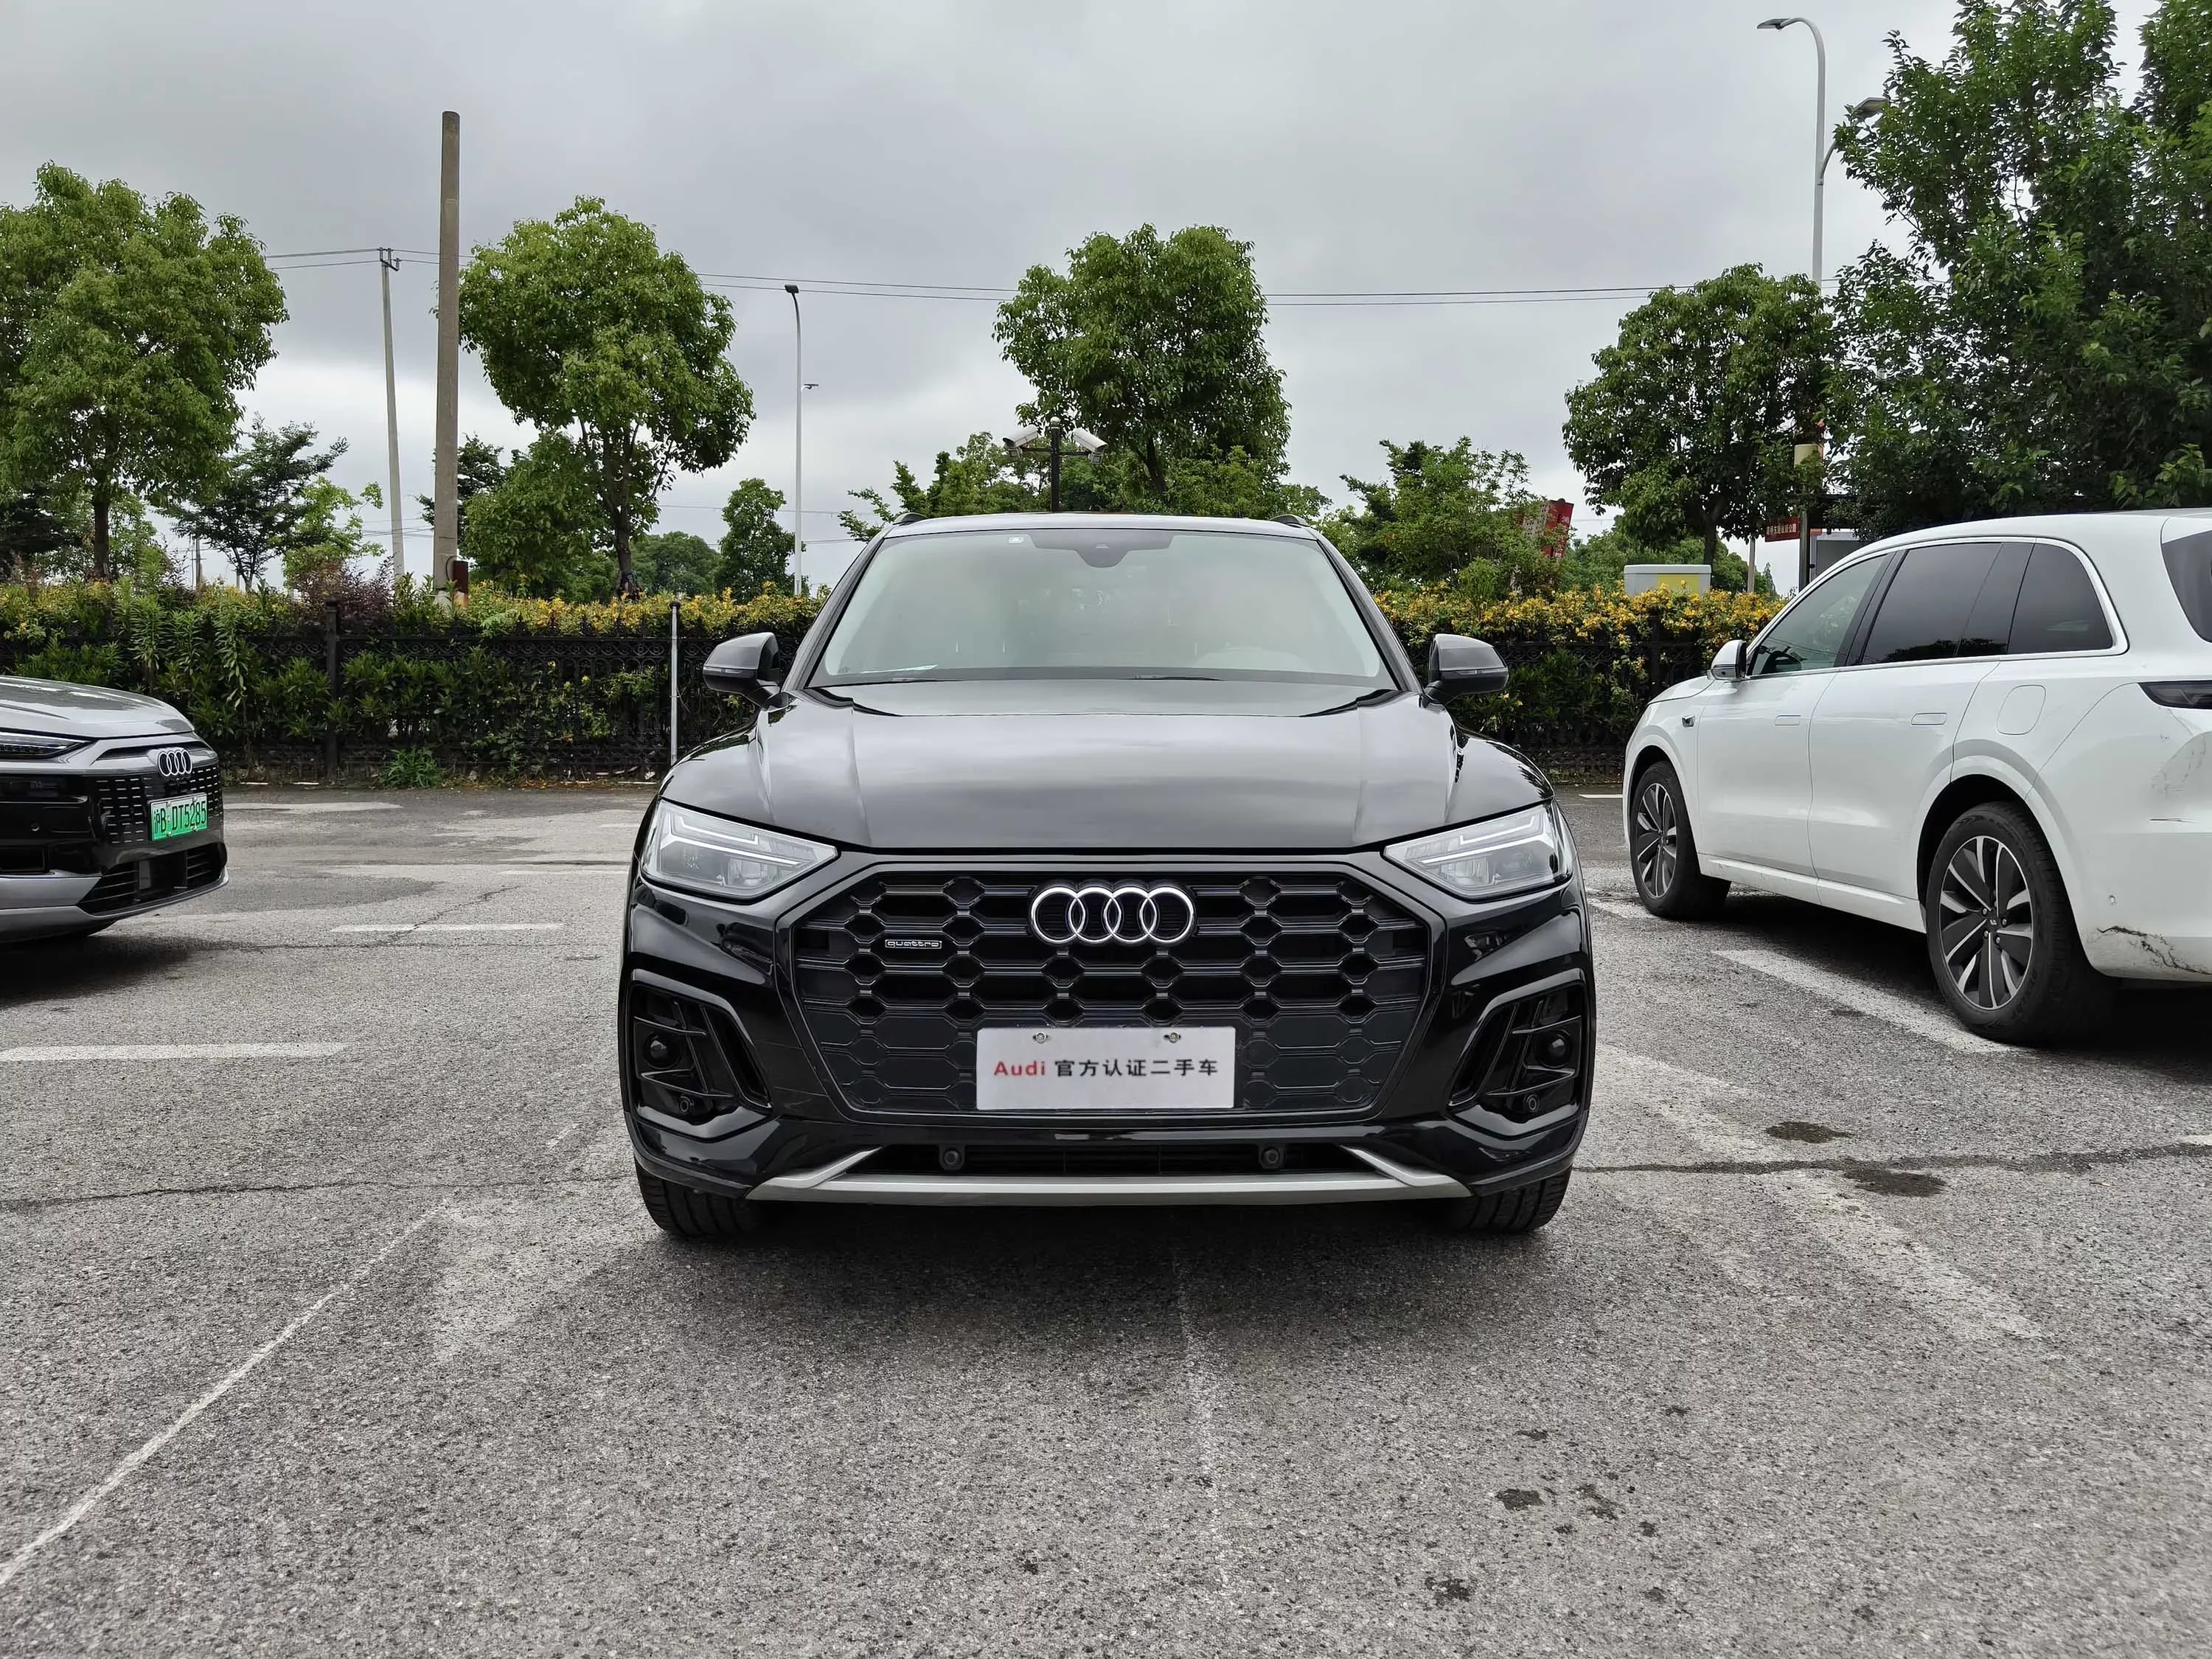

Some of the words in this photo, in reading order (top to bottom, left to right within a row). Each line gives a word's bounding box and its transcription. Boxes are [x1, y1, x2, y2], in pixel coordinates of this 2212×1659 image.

[886, 940, 940, 948] quattro
[994, 1060, 1046, 1077] Audi
[1054, 1058, 1219, 1077] 官方认证二手车
